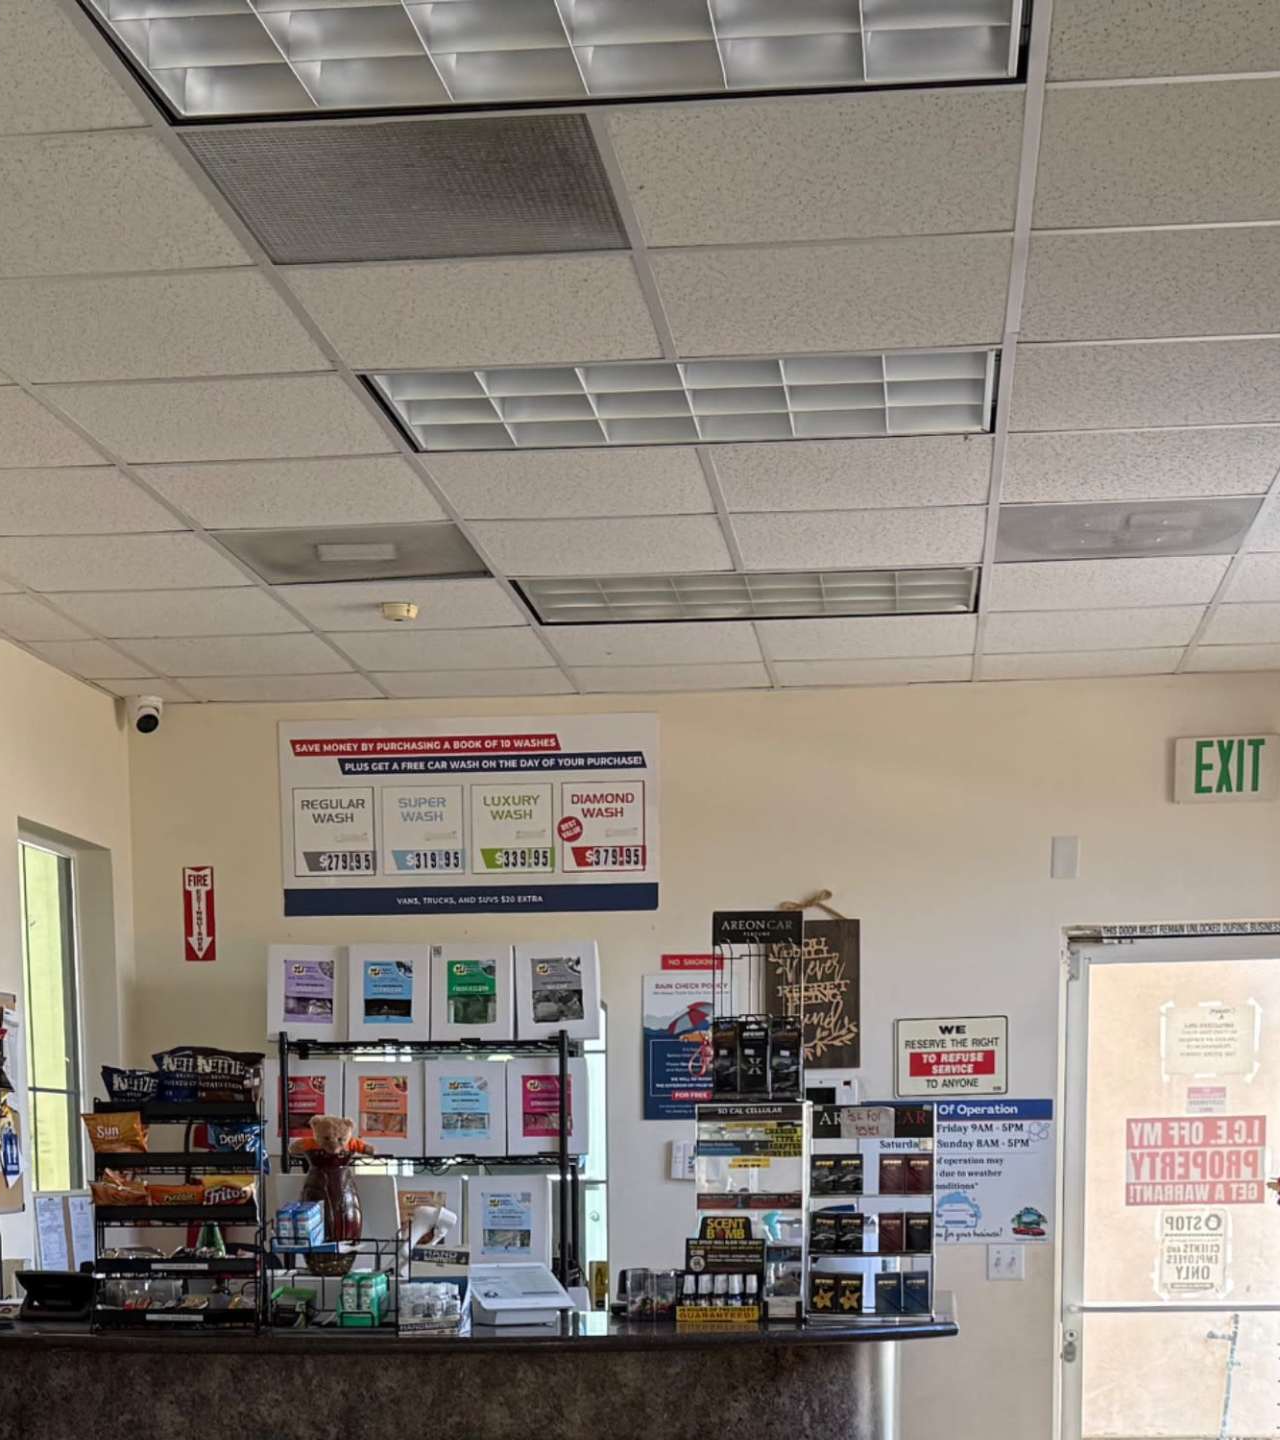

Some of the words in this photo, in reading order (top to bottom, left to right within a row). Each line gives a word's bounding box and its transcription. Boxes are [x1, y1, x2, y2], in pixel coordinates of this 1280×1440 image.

[295, 743, 320, 753] SAVE
[323, 743, 358, 752] MONEY
[361, 743, 375, 752] BY
[376, 741, 440, 751] PURCHASING
[442, 740, 451, 750] A
[452, 739, 482, 750] BOOK
[484, 739, 499, 749] OF
[500, 738, 511, 748] 10
[513, 738, 557, 748] WASHES
[344, 762, 370, 772] PLUS
[371, 761, 390, 772] GET
[391, 761, 401, 771] A
[401, 761, 426, 771] FREE
[427, 760, 448, 770] CAR
[449, 760, 480, 770] WASH
[482, 759, 498, 770] ON
[499, 759, 518, 769] THE
[519, 758, 541, 768] DAY
[542, 757, 556, 768] OF
[557, 757, 585, 767] YOUR
[586, 755, 644, 766] PURCHASE!
[1194, 738, 1265, 794] EXIT
[300, 798, 366, 810] REGULAR
[398, 797, 447, 809] SUPER
[483, 795, 540, 808] LUXURY
[571, 793, 635, 805] DIAMOND
[312, 812, 354, 824] WASH
[401, 810, 444, 822] WASH
[490, 808, 533, 821] WASH
[581, 806, 624, 819] WASH
[187, 874, 209, 887] FIRE
[721, 920, 766, 931] AREON
[766, 920, 793, 931] CAR
[1102, 926, 1117, 935] THIS
[1119, 926, 1138, 935] DOOR
[1139, 925, 1158, 935] MUST
[1159, 924, 1185, 934] REMAIN
[1186, 923, 1221, 934] UNLOCKED
[1222, 922, 1249, 932] DURING
[939, 1025, 967, 1034] WE
[905, 1039, 948, 1049] RESERVE
[950, 1038, 968, 1048] THE
[971, 1037, 1000, 1047] RIGHT
[922, 1053, 937, 1063] TO
[940, 1053, 984, 1063] REFUSE
[931, 1064, 974, 1075] SERVICE
[926, 1079, 939, 1088] TO
[941, 1078, 979, 1088] ANYONE
[745, 1106, 783, 1114] CELLULAR
[938, 1104, 957, 1115] Of
[959, 1104, 1018, 1116] Operation
[96, 1124, 120, 1138] Sun
[936, 1124, 969, 1134] Friday
[970, 1123, 994, 1133] 9AM
[1002, 1123, 1024, 1132] 5PM
[879, 1140, 919, 1149] Saturda
[937, 1139, 974, 1150] Sunday
[976, 1139, 1000, 1148] 8AM
[1007, 1139, 1030, 1148] 5PM
[943, 1157, 985, 1167] operation
[987, 1157, 1004, 1168] may
[939, 1169, 956, 1178] due
[957, 1170, 967, 1178] to
[967, 1169, 1002, 1178] weather
[706, 1218, 746, 1229] SCENT
